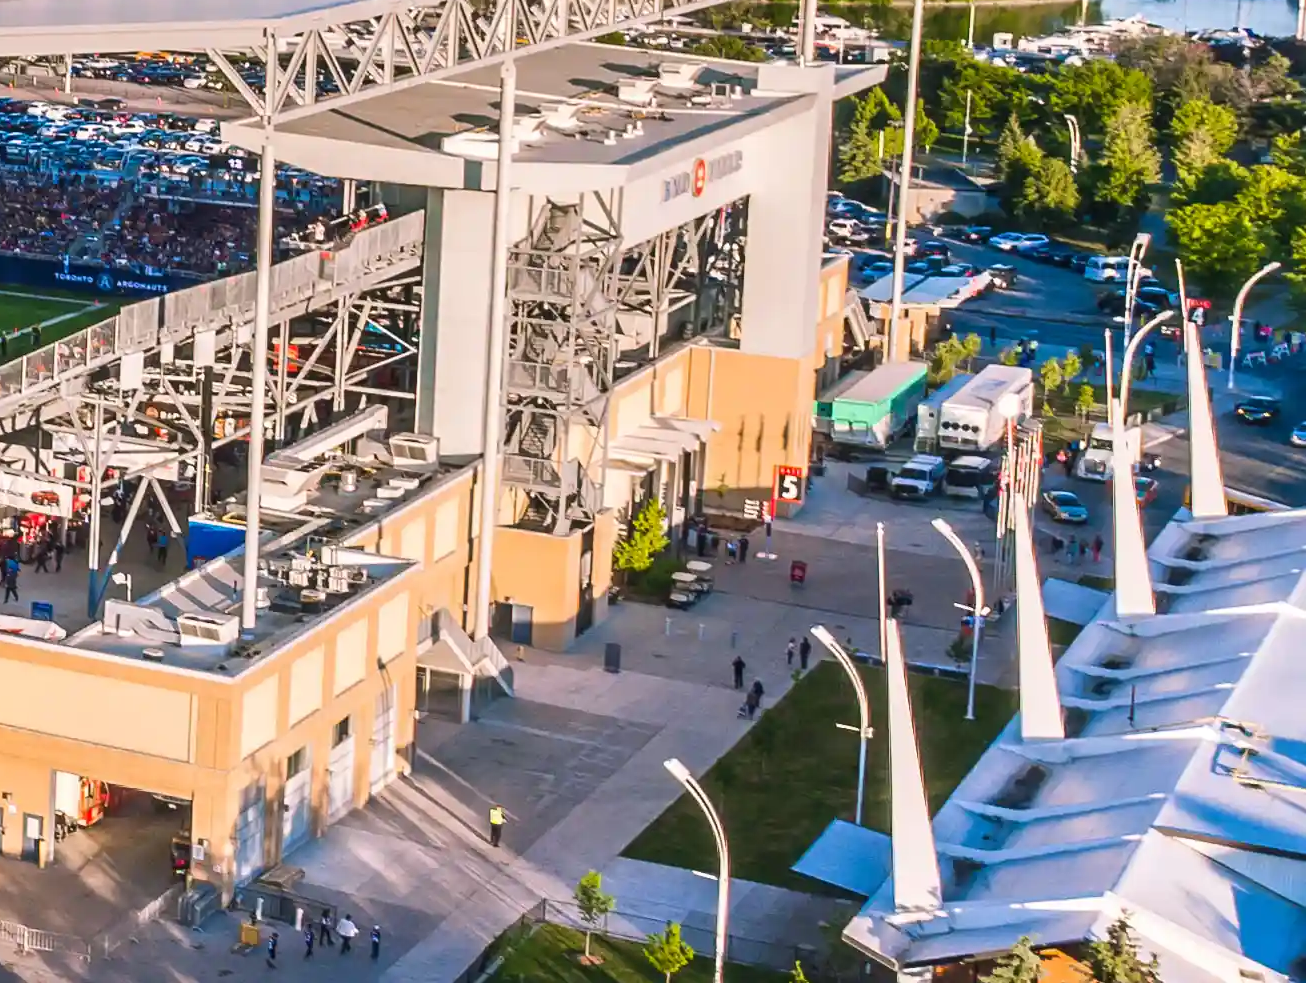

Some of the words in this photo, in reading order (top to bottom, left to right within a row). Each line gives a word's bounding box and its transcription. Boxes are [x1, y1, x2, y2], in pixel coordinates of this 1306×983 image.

[54, 272, 94, 284] TORONTO
[116, 280, 169, 293] ARGONAUTS
[781, 474, 798, 500] 5
